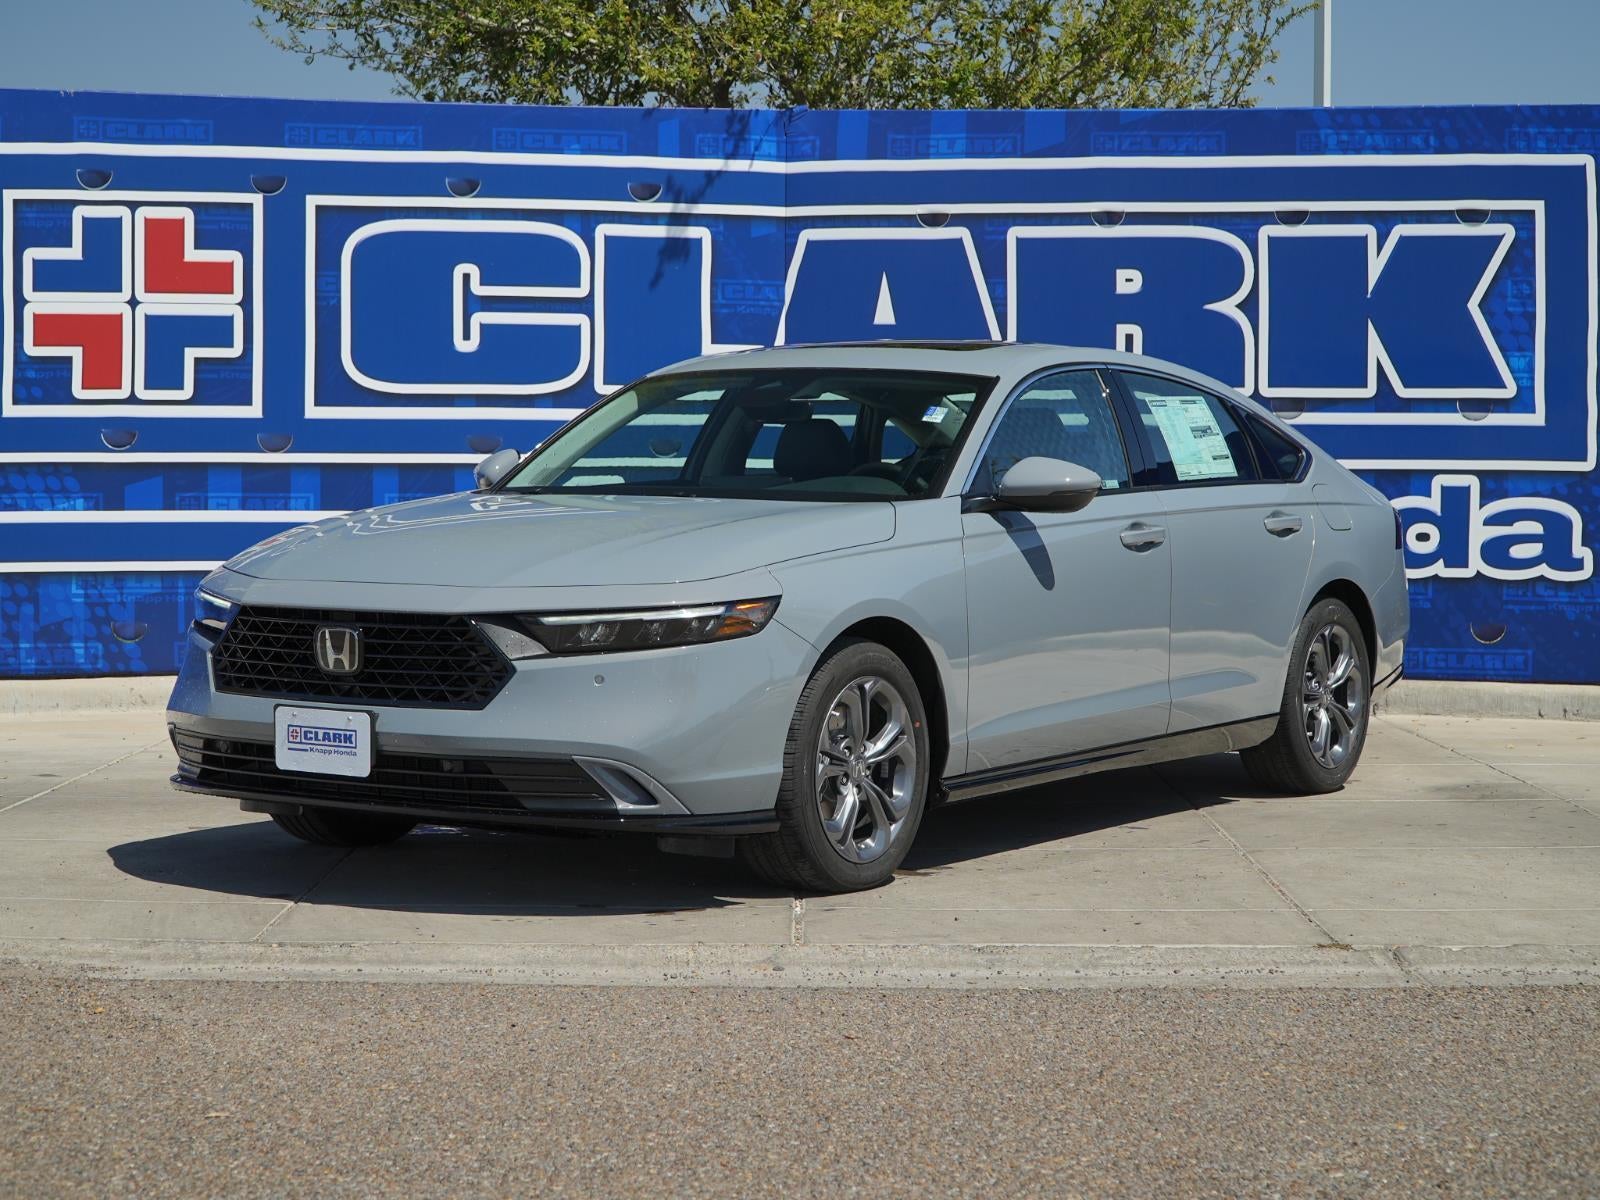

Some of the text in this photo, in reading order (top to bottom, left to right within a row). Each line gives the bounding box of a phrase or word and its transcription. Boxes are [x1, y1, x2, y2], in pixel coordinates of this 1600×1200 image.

[340, 217, 1517, 400] CLARK
[303, 730, 354, 745] CLARK
[309, 746, 357, 757] Knapp Honda
